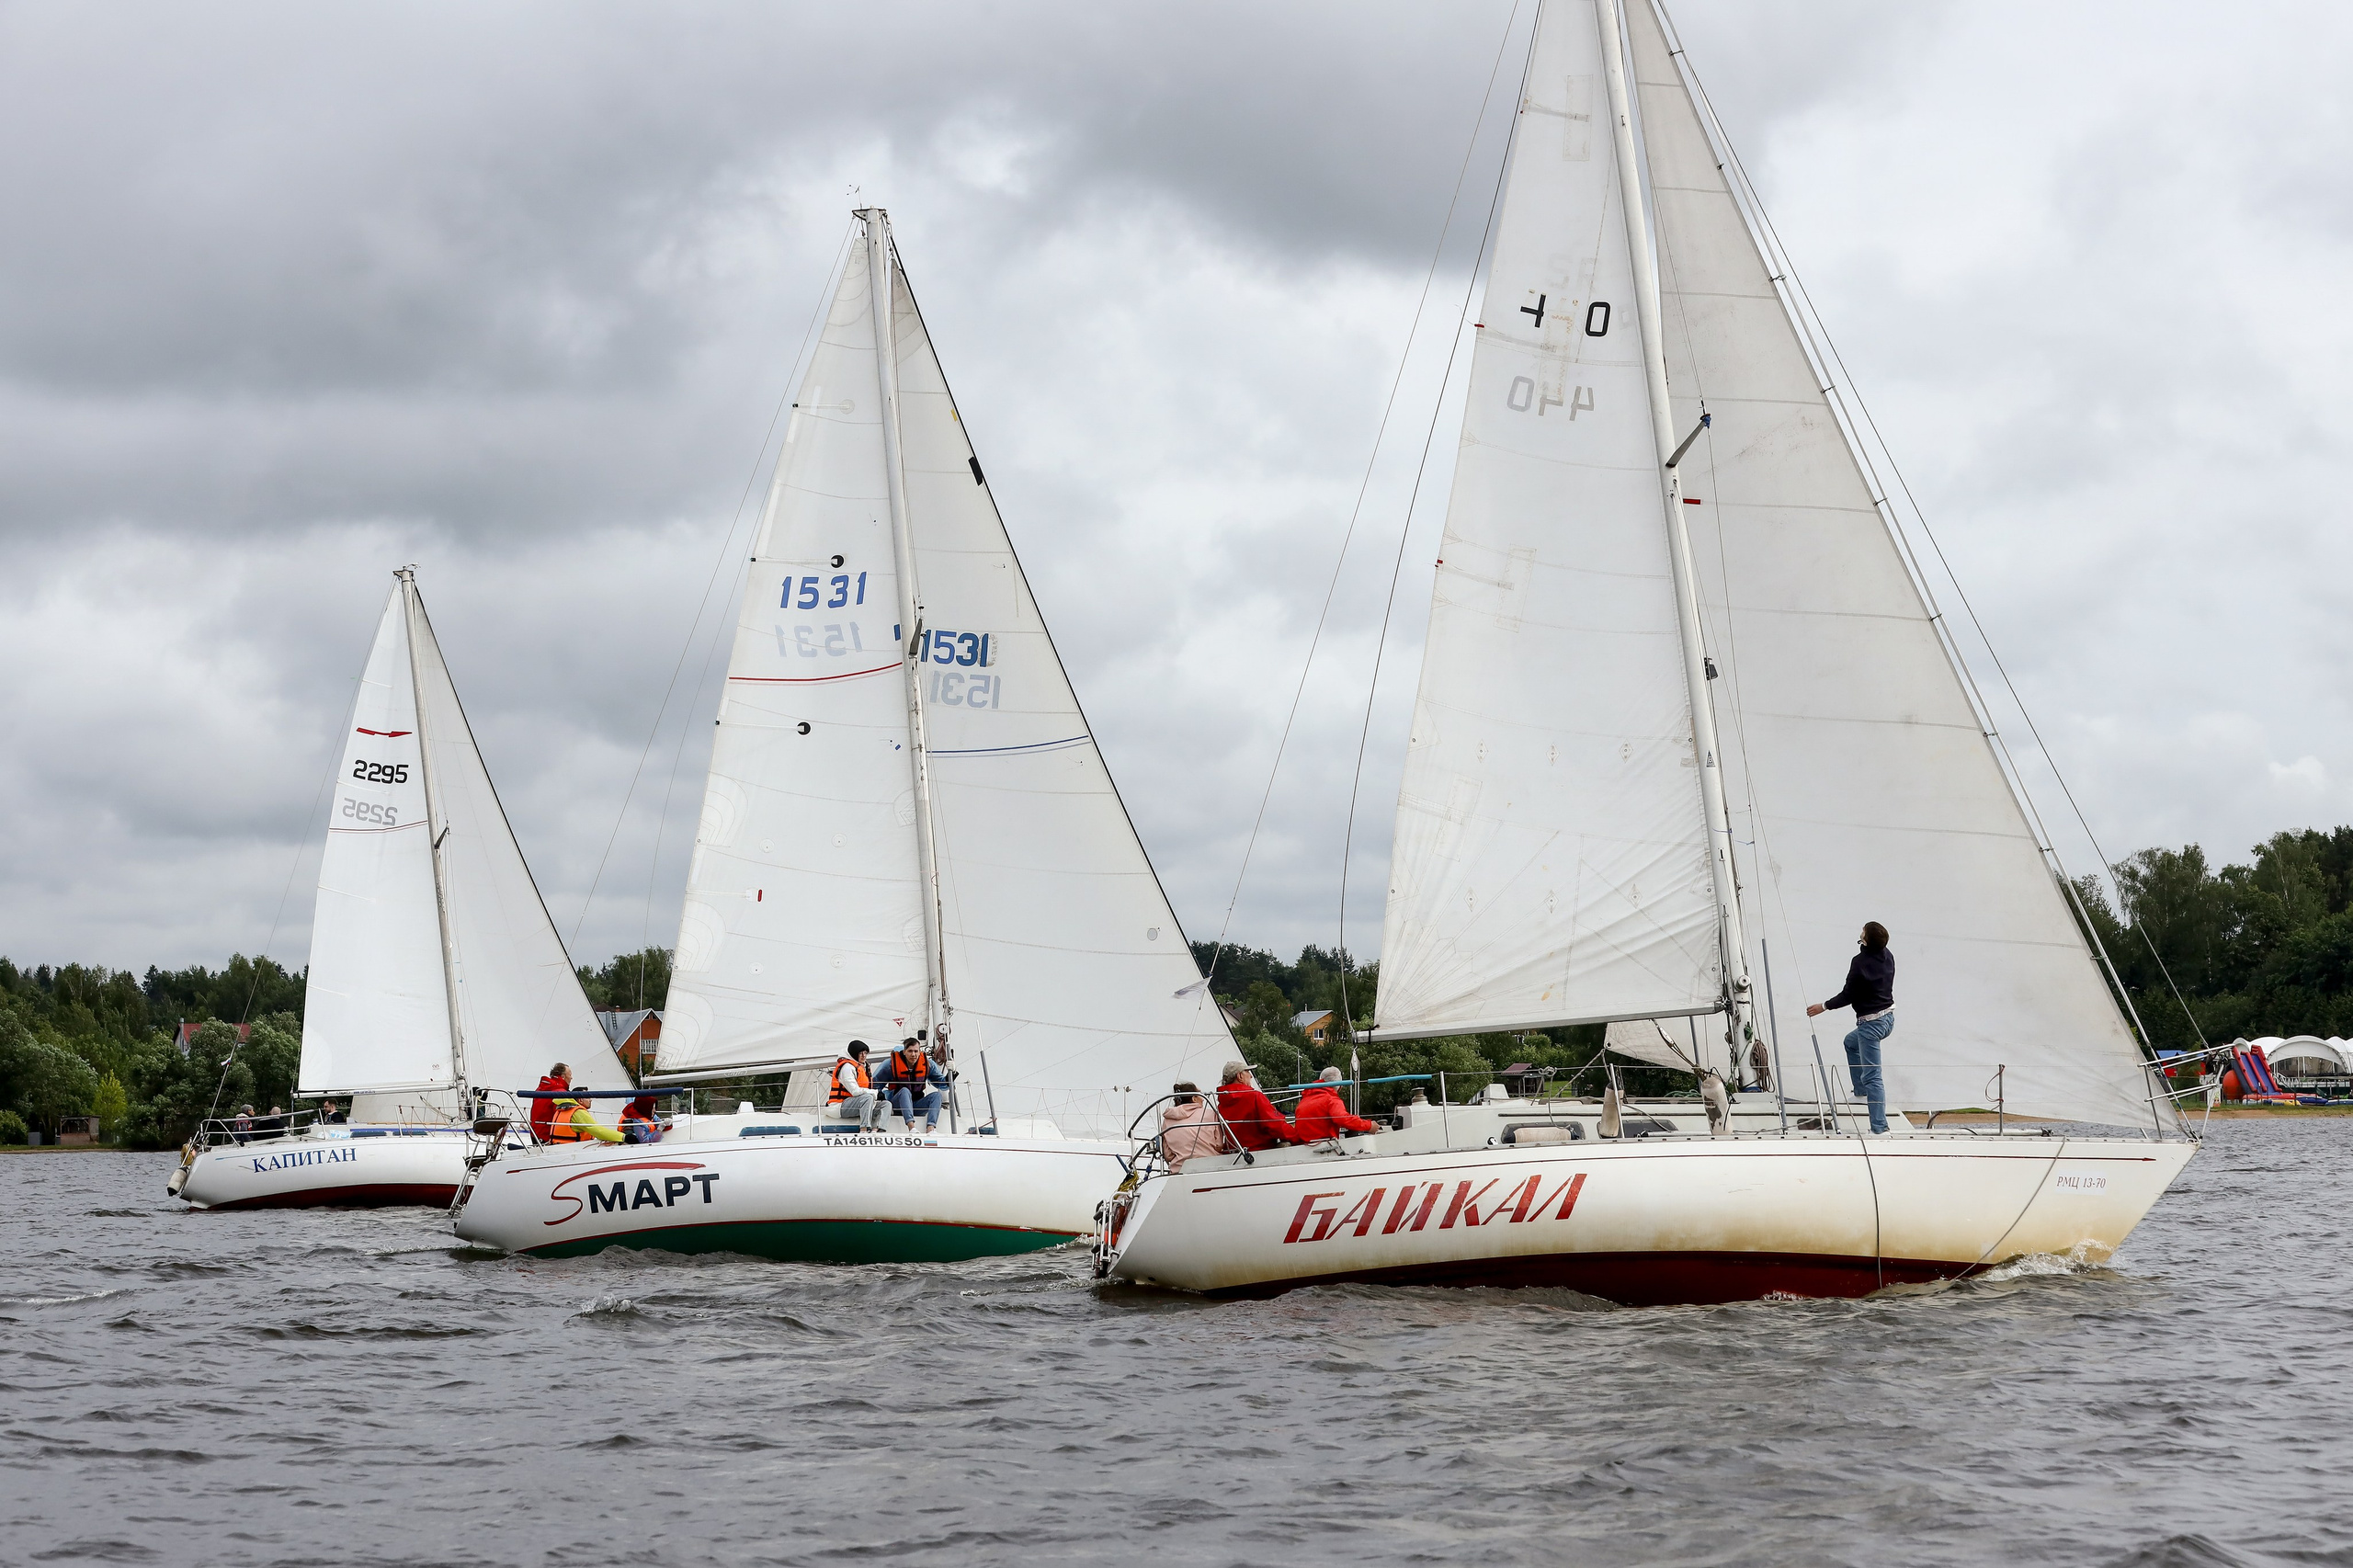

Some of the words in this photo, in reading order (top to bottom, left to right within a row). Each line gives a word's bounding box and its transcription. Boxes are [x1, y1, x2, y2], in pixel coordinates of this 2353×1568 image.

[779, 571, 868, 610] 1531
[919, 629, 990, 668] 1531
[353, 759, 410, 784] 2295
[252, 1147, 358, 1174] КАПИТАН
[2083, 1177, 2107, 1188] 13-70
[1282, 1172, 1588, 1244] БАЙКАЛ
